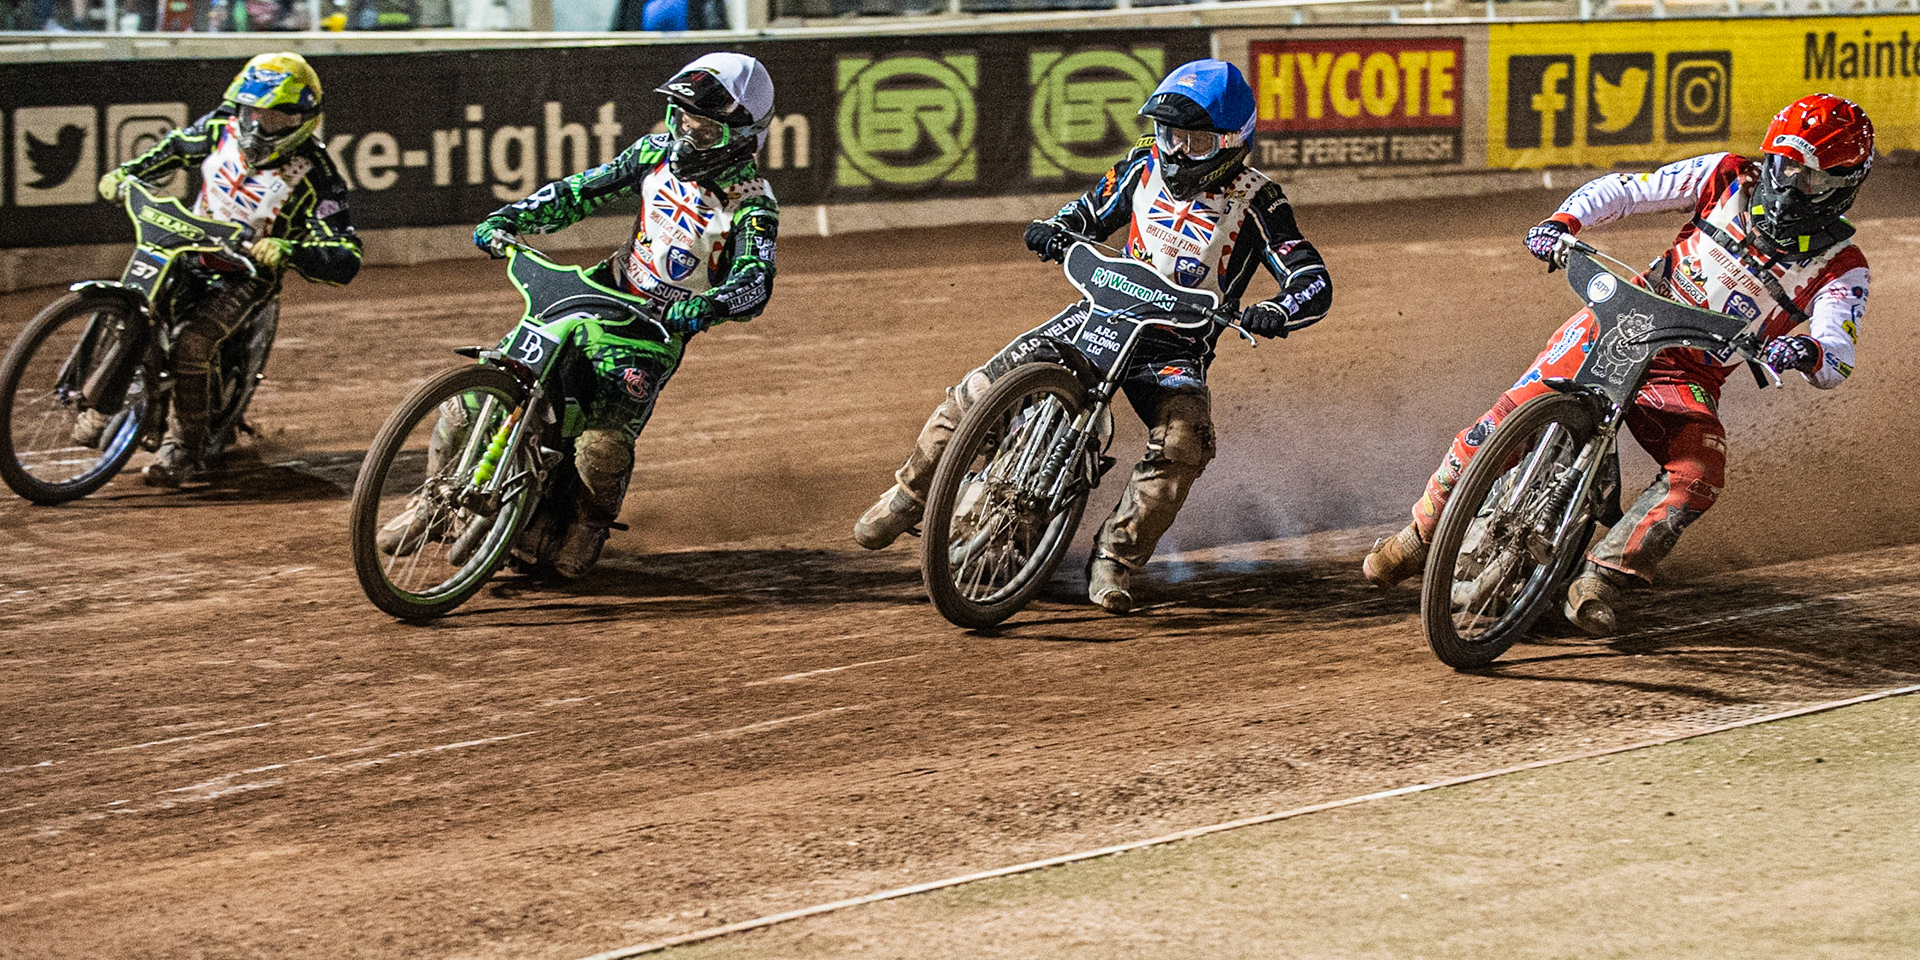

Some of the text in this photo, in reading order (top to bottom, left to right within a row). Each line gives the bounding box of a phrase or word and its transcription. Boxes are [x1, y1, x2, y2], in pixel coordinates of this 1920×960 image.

[1257, 51, 1456, 120] HYCOTE
[1258, 138, 1298, 165] THE
[1145, 224, 1202, 256] BRITISH FINAL
[1160, 243, 1180, 258] 2019
[130, 259, 159, 279] 37
[669, 247, 697, 268] SGB
[1177, 258, 1207, 276] SGB
[1708, 246, 1764, 297] BRITISH FINAL
[1717, 272, 1738, 291] 2019
[1108, 272, 1153, 303] Warren
[1150, 289, 1178, 312] Ltd
[1730, 294, 1758, 320] SGB
[1041, 309, 1090, 338] WELDIN
[1081, 330, 1121, 353] WELDING
[1085, 343, 1103, 356] Ltd
